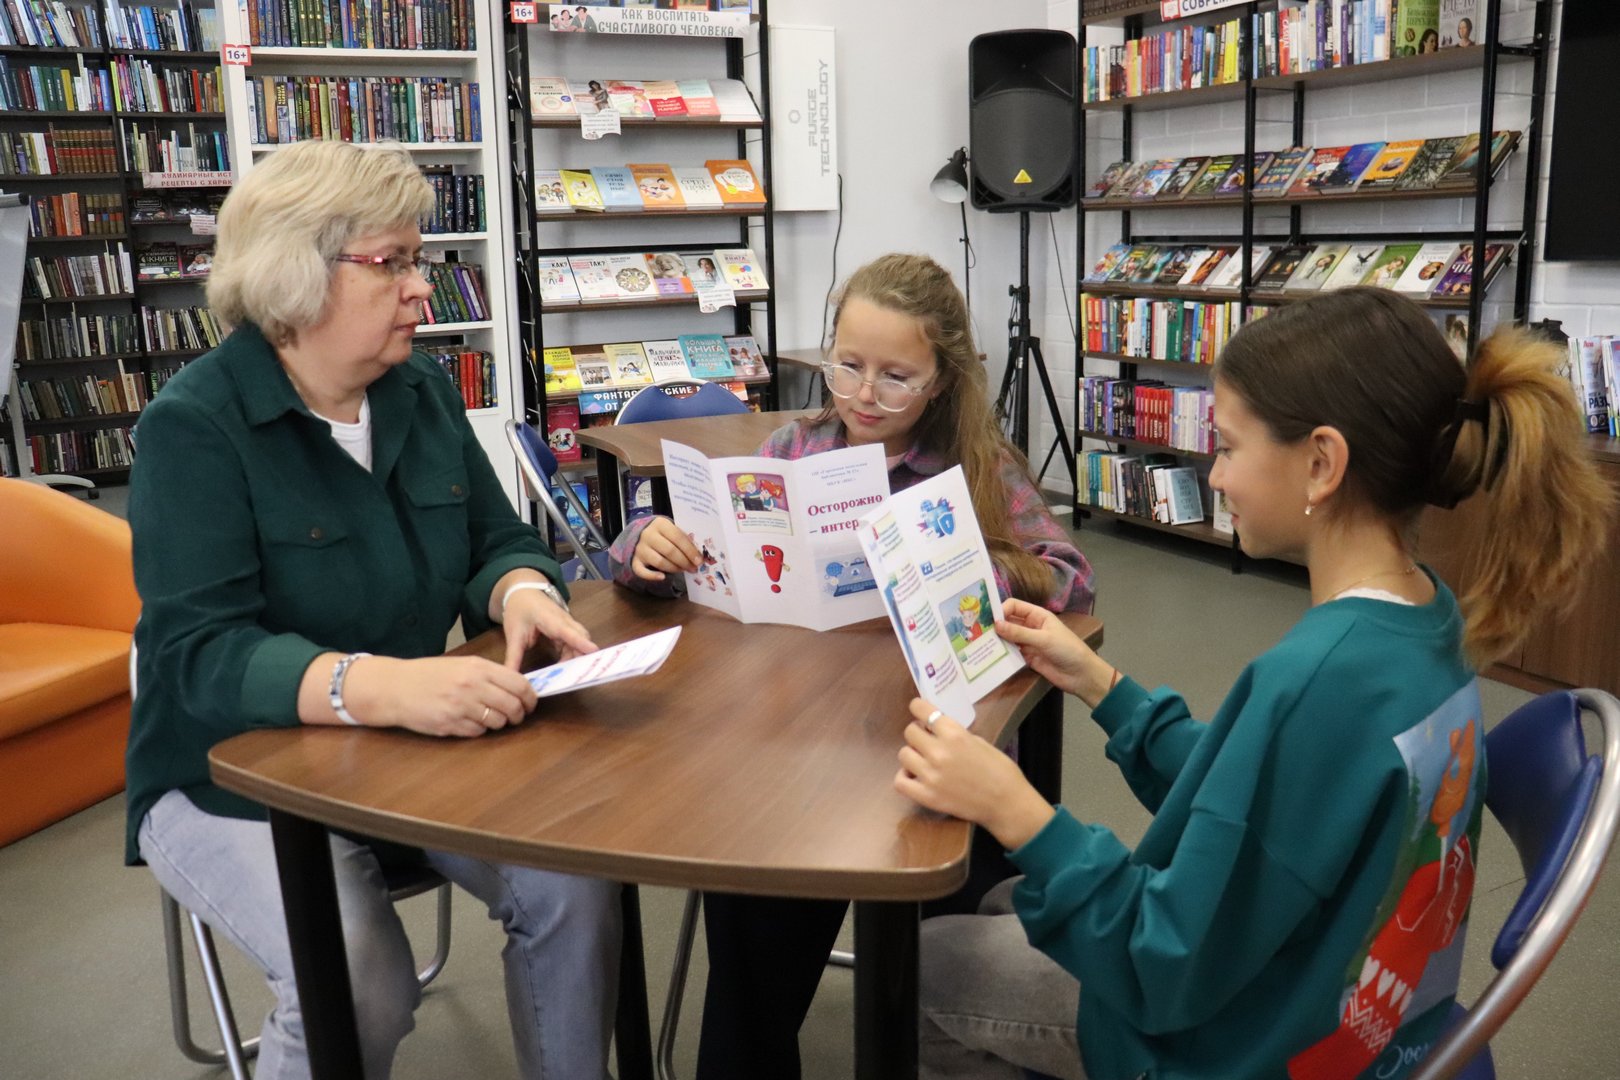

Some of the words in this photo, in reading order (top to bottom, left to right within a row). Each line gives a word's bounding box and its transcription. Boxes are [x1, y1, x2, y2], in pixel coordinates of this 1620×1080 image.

[515, 8, 533, 17] 16+
[621, 9, 643, 20] КАК
[647, 10, 709, 22] ВОСПИТАТЬ
[598, 21, 677, 34] СЧАСТЛИВОГО
[680, 25, 734, 36] ЧЕЛОВЕКА
[227, 50, 246, 59] 16+
[819, 59, 830, 176] TECHNOLOGY
[686, 345, 724, 353] КНИГА
[604, 402, 618, 411] ОТ
[808, 495, 883, 516] Осторожно
